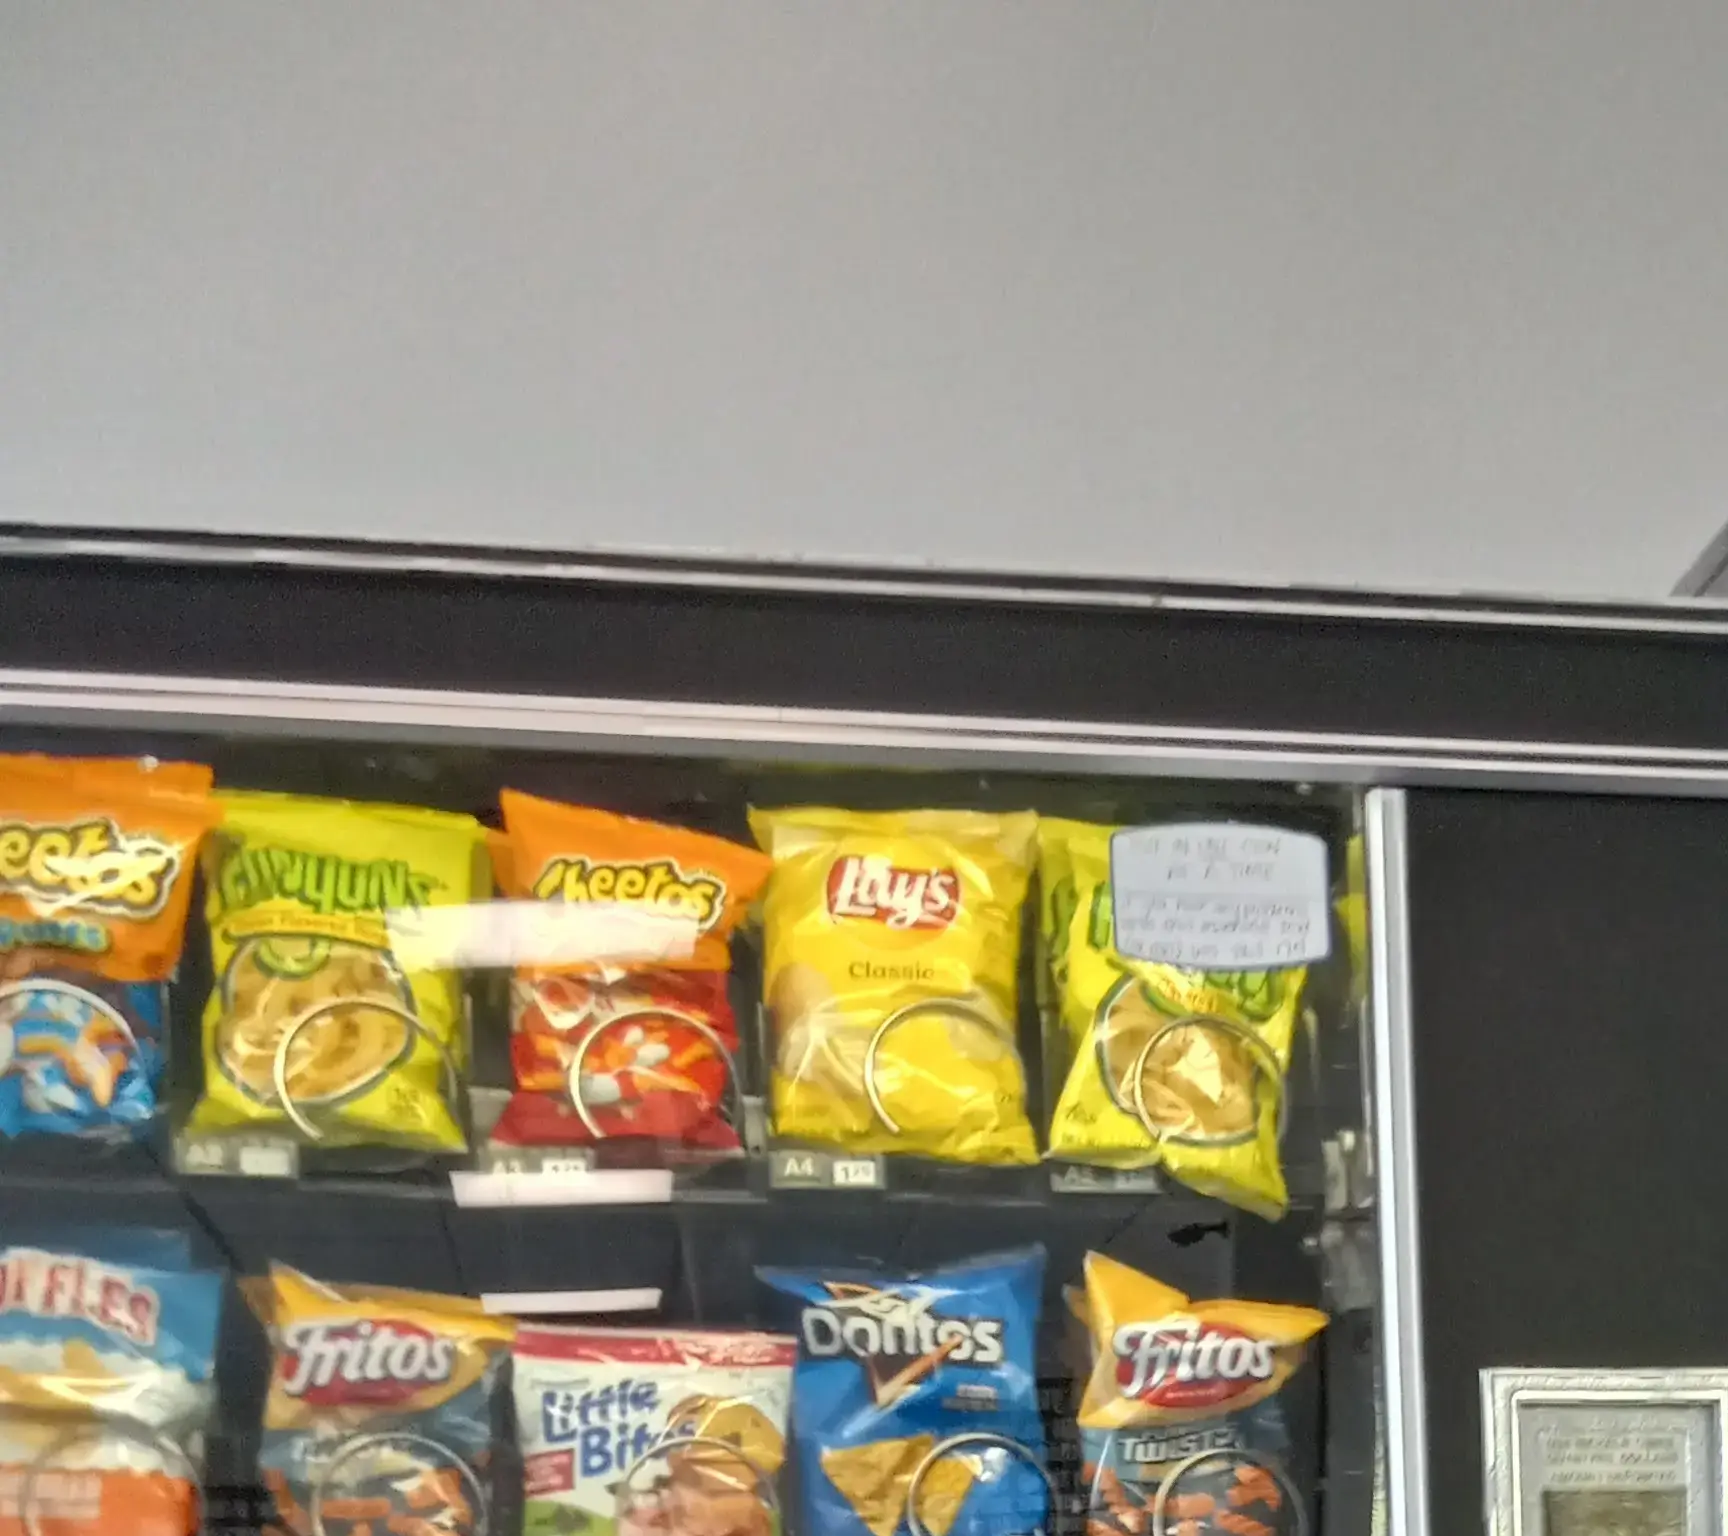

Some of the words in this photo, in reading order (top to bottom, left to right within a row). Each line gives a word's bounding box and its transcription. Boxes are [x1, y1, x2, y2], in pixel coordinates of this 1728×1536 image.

[0, 823, 160, 904] eetos
[828, 856, 958, 930] Lay's
[847, 958, 936, 982] Classic
[784, 1156, 815, 1177] A4
[285, 1318, 460, 1396] Fritos
[802, 1306, 1003, 1364] Doritos
[1114, 1318, 1280, 1401] Fritos
[541, 1376, 660, 1444] Little
[580, 1420, 696, 1479] Bites
